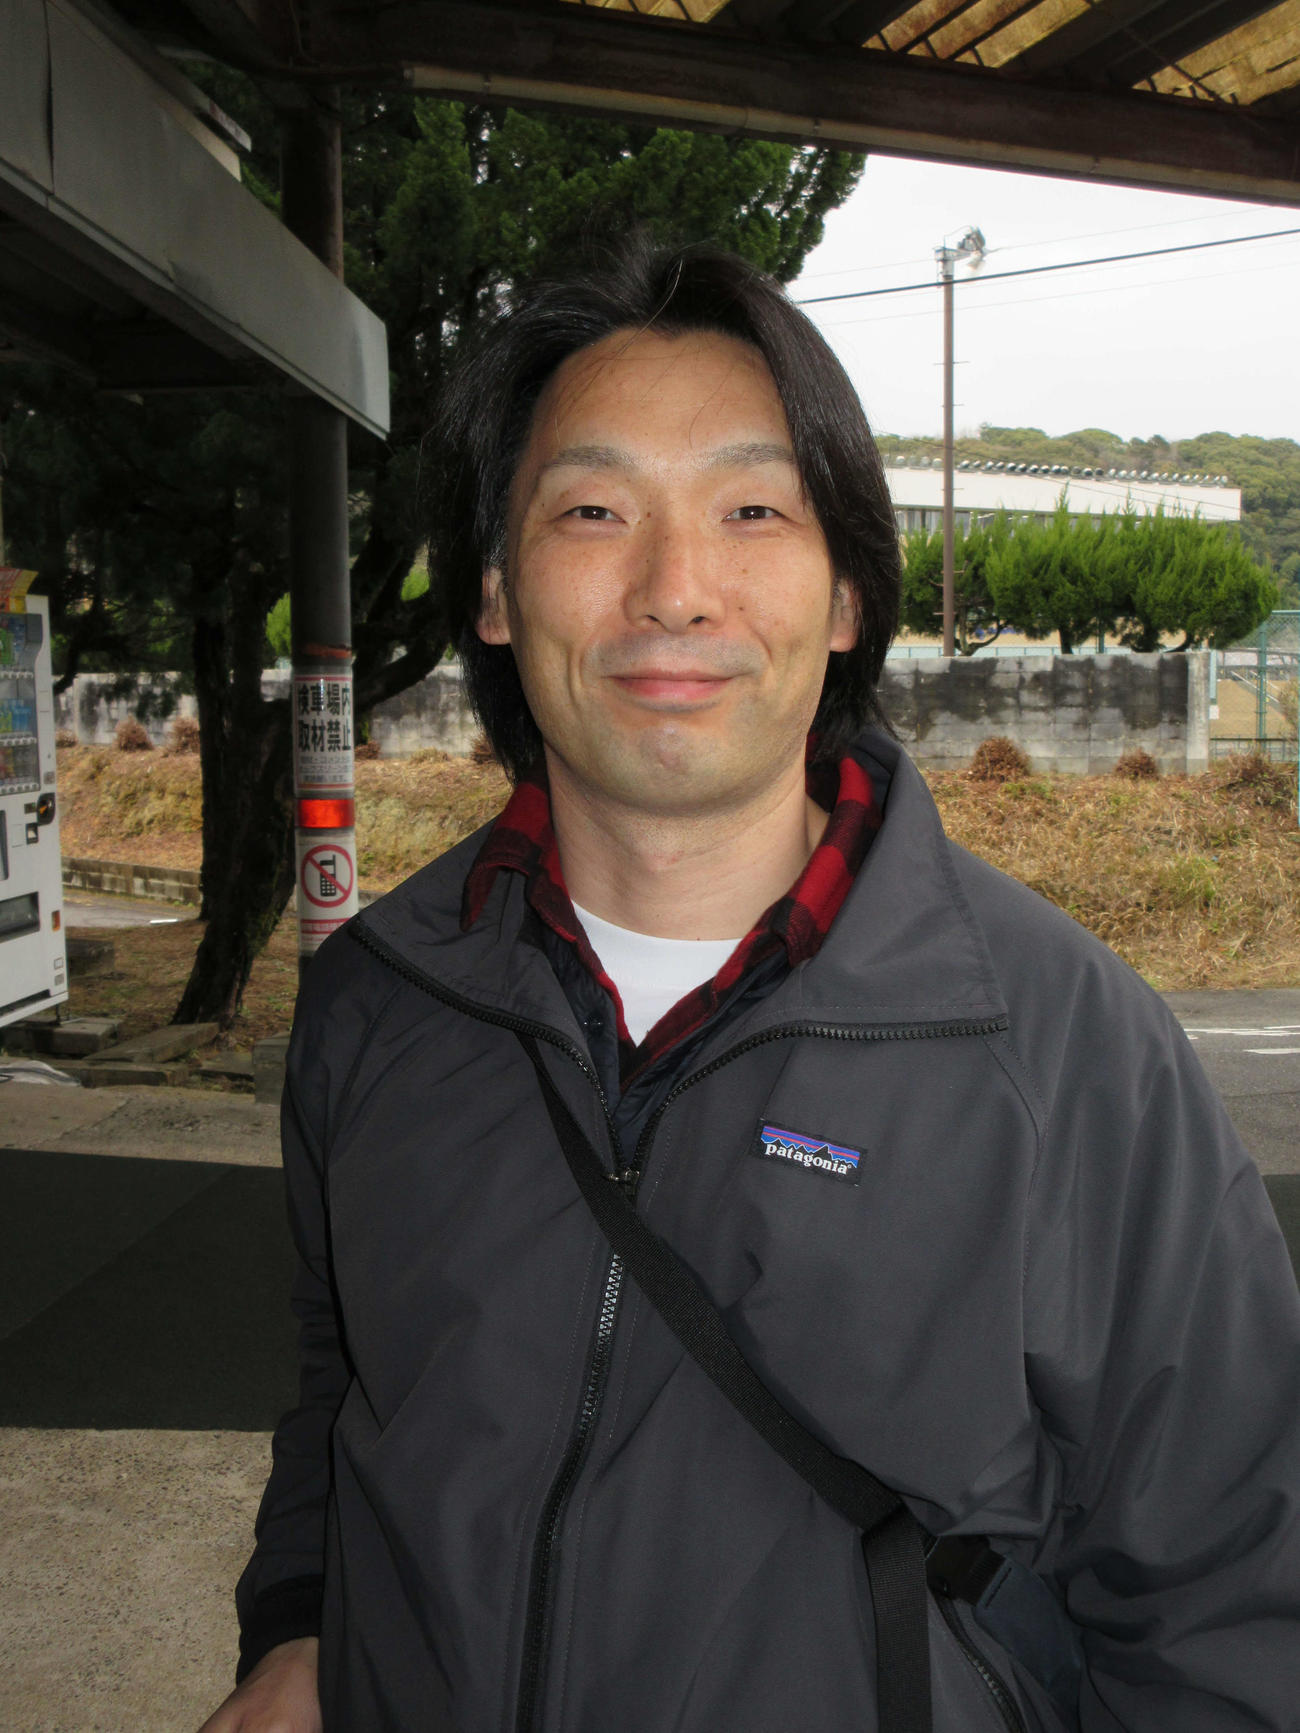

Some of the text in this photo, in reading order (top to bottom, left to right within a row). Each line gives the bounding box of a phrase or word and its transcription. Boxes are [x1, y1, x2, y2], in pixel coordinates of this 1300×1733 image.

[298, 718, 351, 752] 取材禁止
[764, 1143, 848, 1175] patagonia
